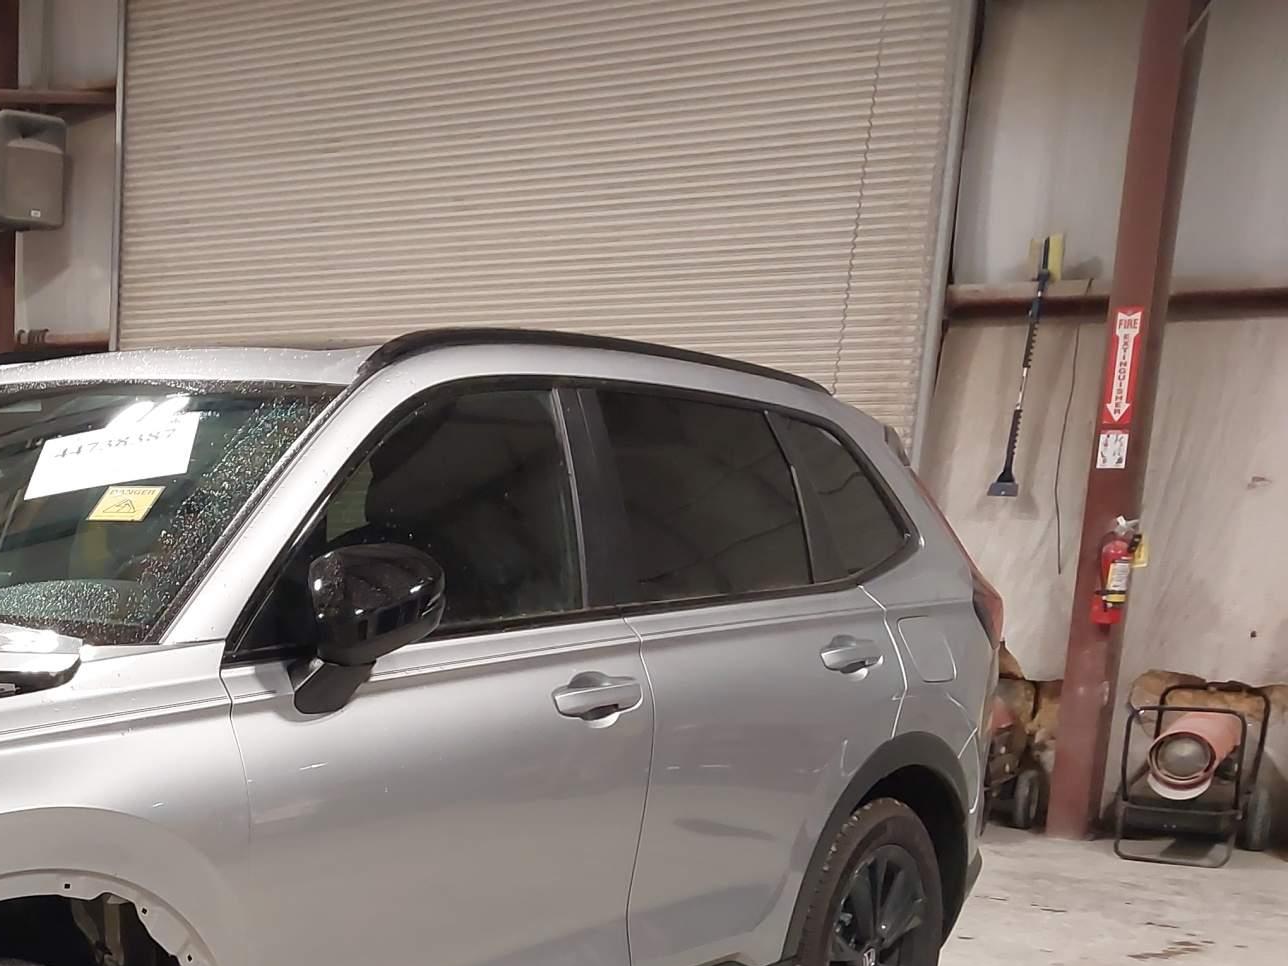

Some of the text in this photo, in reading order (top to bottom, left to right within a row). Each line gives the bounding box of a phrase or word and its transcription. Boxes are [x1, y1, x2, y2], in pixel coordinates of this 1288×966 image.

[1118, 318, 1139, 329] FIRE
[1114, 333, 1129, 415] EXTINGUISHER
[109, 488, 157, 496] DANGER
